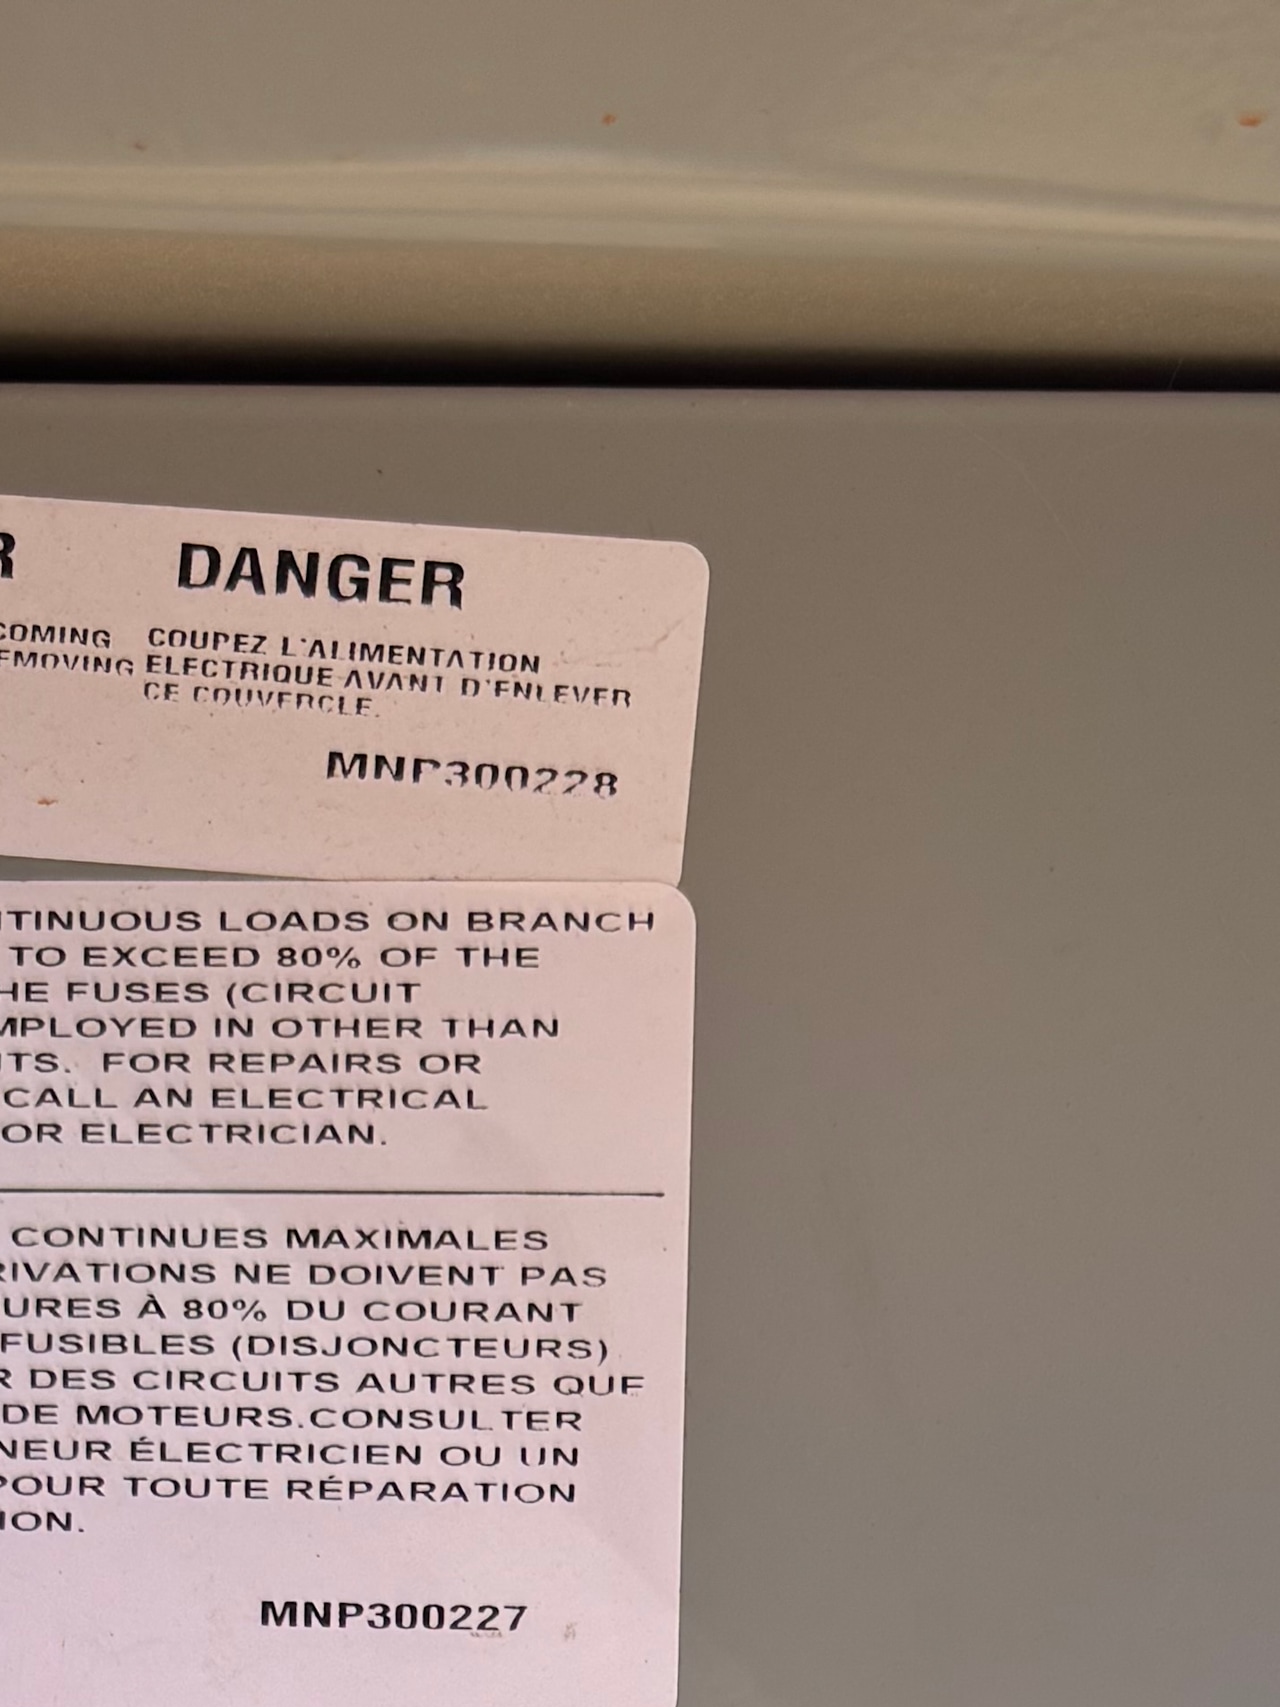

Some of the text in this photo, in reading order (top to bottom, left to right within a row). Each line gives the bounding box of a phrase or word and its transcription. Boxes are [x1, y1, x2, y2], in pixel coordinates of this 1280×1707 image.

[177, 541, 465, 611] DANGER
[147, 627, 268, 656] COUPEZ
[219, 910, 370, 932] LOADS
[386, 910, 449, 932] ON
[467, 910, 655, 933] BRANCH
[8, 945, 67, 968] TO
[83, 945, 261, 968] EXCEED
[277, 946, 362, 969] 80%
[379, 946, 438, 968] OF
[455, 946, 540, 969] THE
[66, 981, 209, 1003] FUSES
[226, 981, 422, 1008] (CIRCUIT
[214, 1017, 254, 1038] IN
[271, 1017, 422, 1039] OTHER
[441, 1017, 559, 1039] THAN
[102, 1052, 191, 1074] FOR
[209, 1052, 402, 1075] REPAIRS
[419, 1053, 481, 1075] OR
[3, 1086, 118, 1109] CALL
[133, 1087, 193, 1108] AN
[211, 1087, 488, 1110] ELECTRICAL
[1, 1122, 63, 1144] OR
[81, 1122, 387, 1146] ELECTRICIAN.
[11, 1226, 268, 1249] CONTINUES
[286, 1227, 549, 1251] MAXIMALES
[234, 1262, 291, 1285] NE
[309, 1263, 505, 1287] DOIVENT
[520, 1265, 607, 1288] PAS
[137, 1293, 167, 1320] À
[183, 1298, 267, 1322] 80%
[286, 1299, 345, 1321] DU
[363, 1300, 583, 1323] COURANT
[0, 1331, 215, 1356] FUSIBLES
[231, 1334, 608, 1366] (DISJONCTEURS)
[260, 1600, 528, 1638] MNP300227
